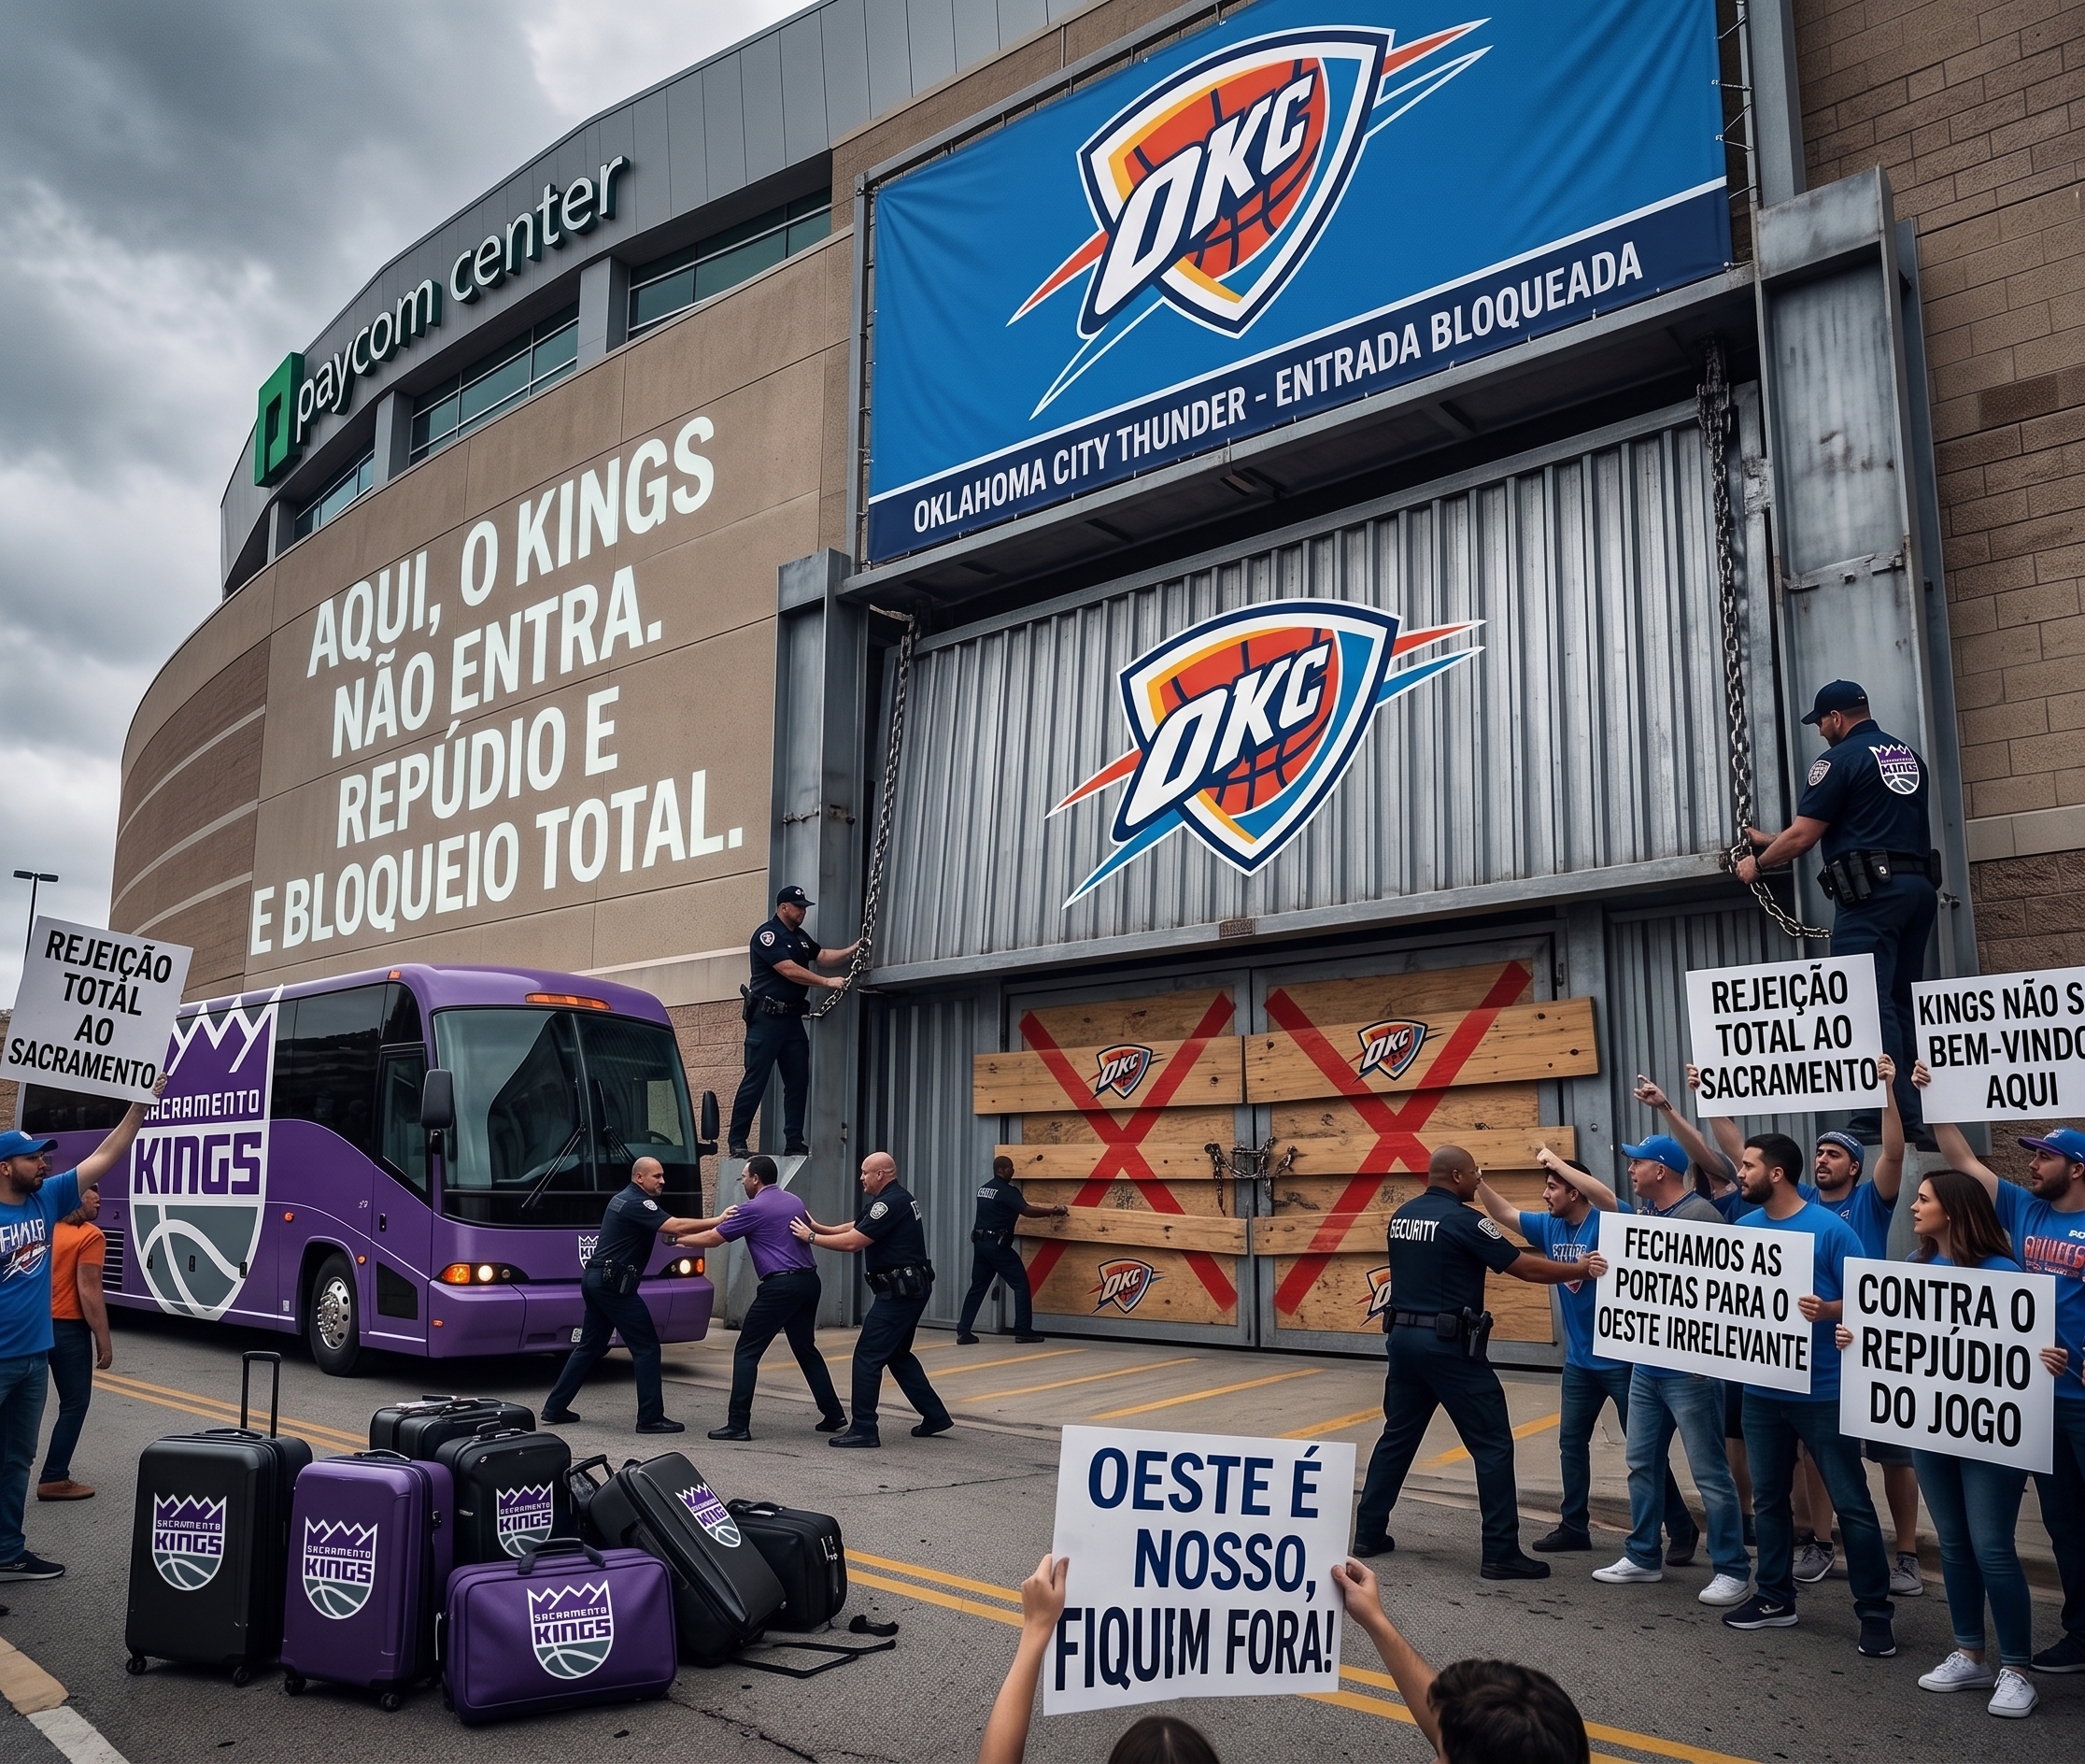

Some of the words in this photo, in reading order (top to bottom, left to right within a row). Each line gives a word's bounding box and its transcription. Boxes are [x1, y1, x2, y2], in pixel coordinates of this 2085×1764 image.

[1095, 75, 1313, 316] OKC
[295, 278, 440, 444] paycom
[450, 155, 628, 304] center
[914, 458, 1047, 534] OKLAHOMA
[1053, 435, 1112, 486] CITY
[1115, 385, 1247, 461] THUNDER
[1276, 322, 1422, 409] ENTRADA
[1431, 241, 1643, 352] BLOQUEADA
[306, 550, 441, 677] AQUI,
[461, 520, 498, 606] O
[516, 416, 715, 587] KINGS
[332, 648, 435, 759] NÃO
[450, 564, 662, 716] ENTRA.
[1126, 644, 1328, 826] OKC
[336, 720, 566, 848] REPÚDIO
[585, 686, 619, 776] E
[250, 886, 275, 956] E
[282, 821, 519, 948] BLOQUEIO
[535, 769, 744, 889] TOTAL.
[45, 930, 172, 983] REJEIÇÃO
[63, 972, 142, 1017] TOTAL
[1712, 964, 1849, 1016] REJEIÇÃO
[1918, 989, 1995, 1025] KINGS
[2002, 977, 2058, 1019] NÃO
[74, 1014, 114, 1046] AO
[1362, 1029, 1410, 1069] OKC
[1715, 1017, 1806, 1057] TOTAL
[1813, 1015, 1852, 1050] AO
[7, 1037, 157, 1089] SACRAMENTO
[1099, 1053, 1139, 1088] OKC
[1700, 1058, 1879, 1100] SACRAMENTO
[1986, 1072, 2058, 1110] AQUI
[135, 1131, 262, 1195] KINGS
[1390, 1218, 1440, 1243] SECURITY
[1625, 1227, 1744, 1272] FECHAMOS
[1751, 1243, 1782, 1277] AS
[1101, 1269, 1141, 1301] OKC
[1615, 1268, 1698, 1311] PORTAS
[1706, 1279, 1765, 1321] PARA
[1773, 1288, 1789, 1322] O
[1858, 1273, 1999, 1330] CONTRA
[2010, 1288, 2035, 1333] O
[1598, 1305, 1660, 1347] OESTE
[1667, 1316, 1808, 1372] IRRELEVANTE
[1862, 1325, 2032, 1390] REPJÚDIO
[1870, 1381, 1916, 1430] DO
[1928, 1392, 2022, 1447] JOGO
[1087, 1447, 1273, 1516] OESTE
[1290, 1445, 1322, 1518] É
[155, 1532, 222, 1556] KINGS
[499, 1512, 551, 1532] KINGS
[305, 1558, 372, 1584] KINGS
[1134, 1529, 1316, 1602] NOSSO,
[534, 1618, 611, 1645] KINGS
[1226, 1609, 1335, 1675] FORA!
